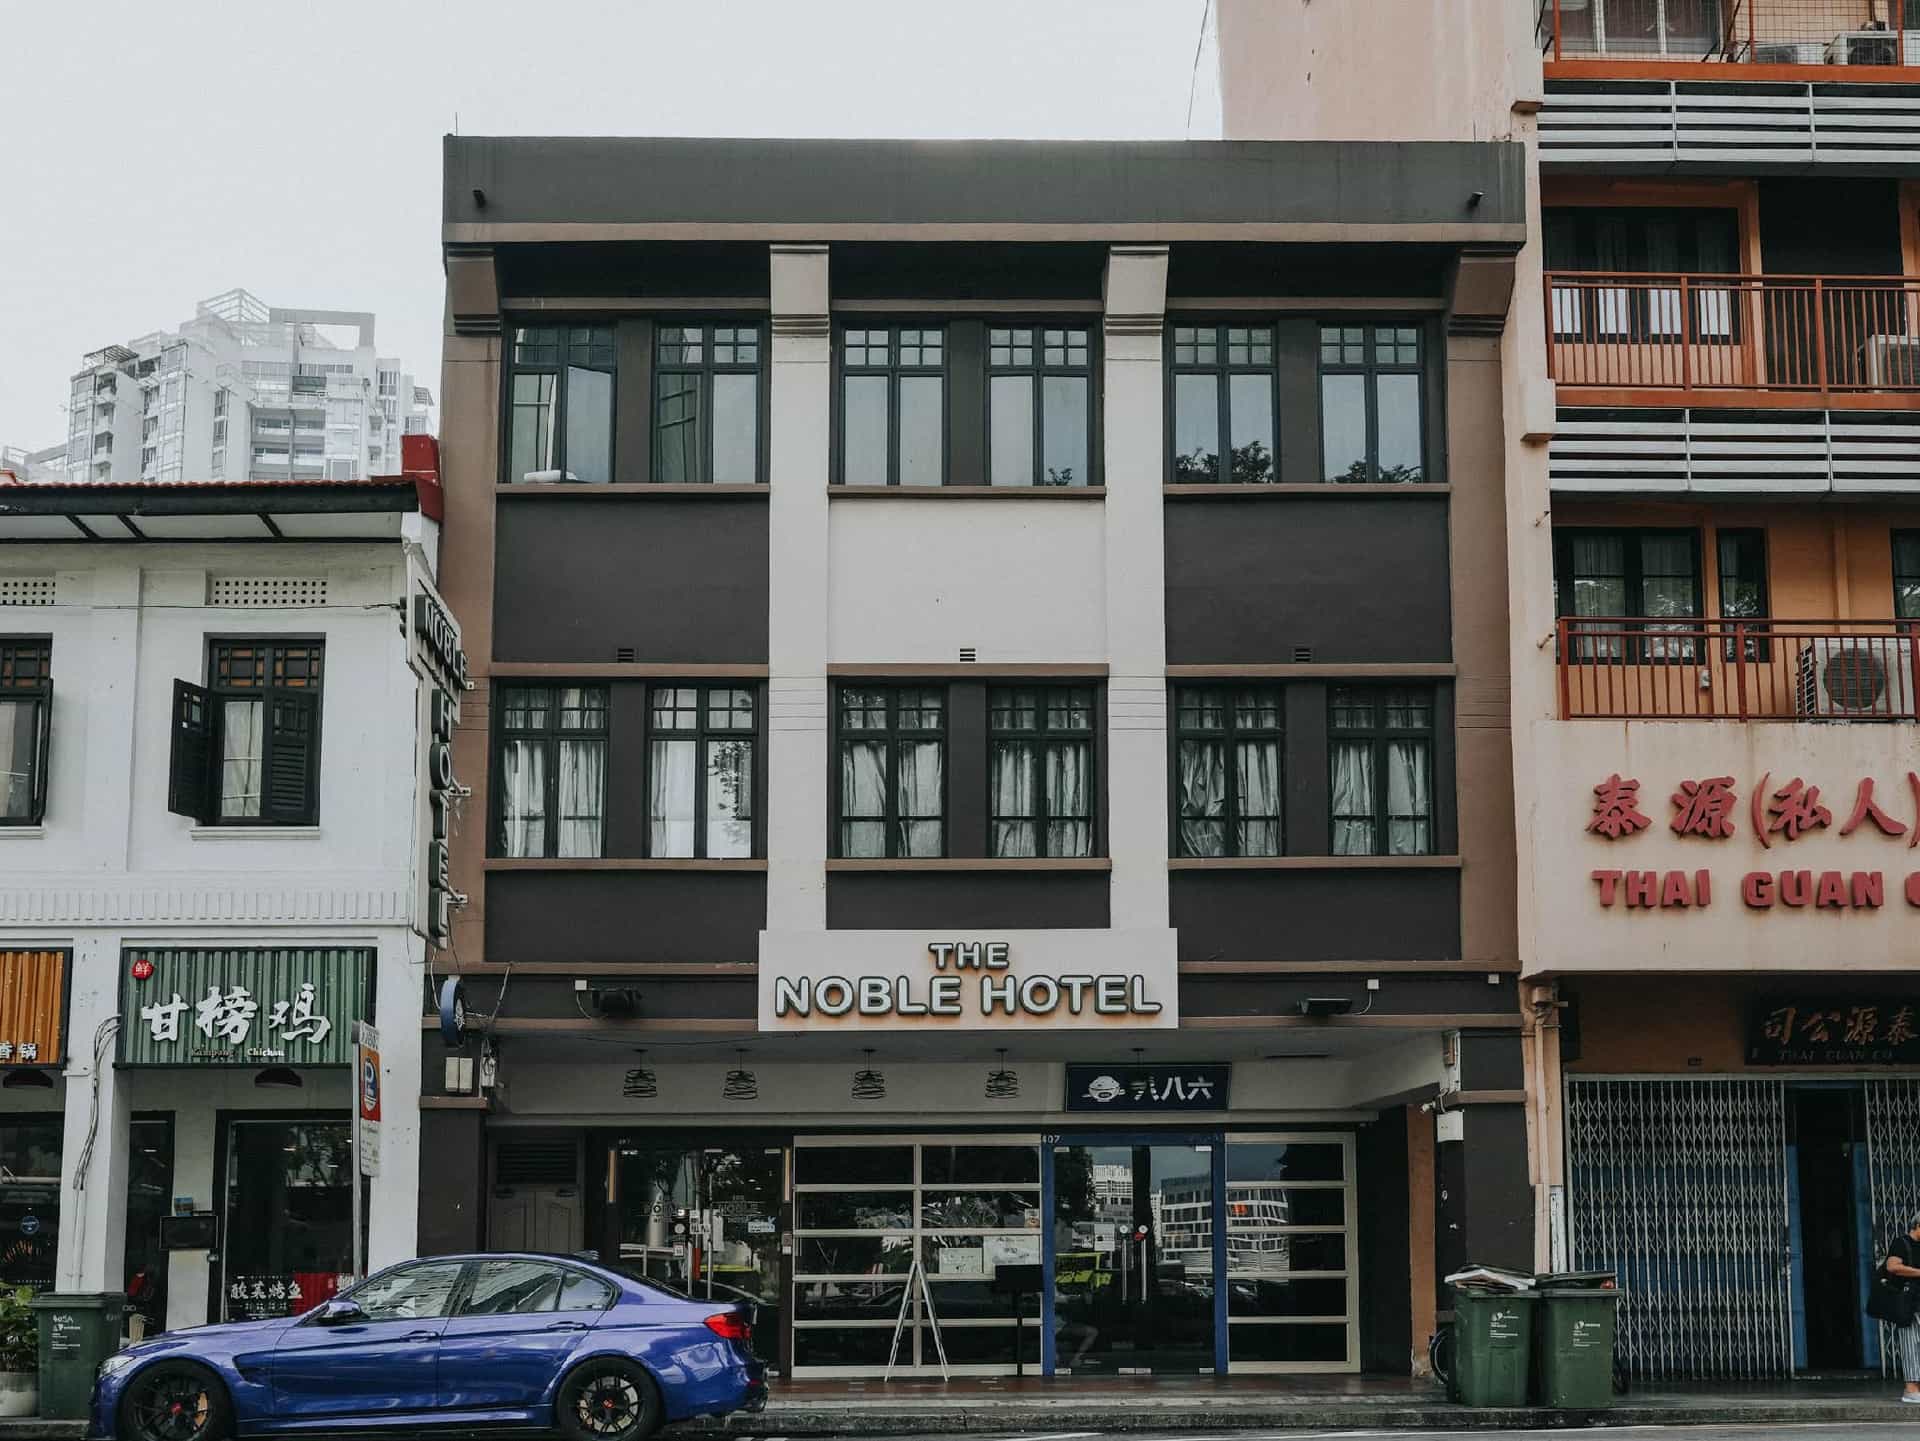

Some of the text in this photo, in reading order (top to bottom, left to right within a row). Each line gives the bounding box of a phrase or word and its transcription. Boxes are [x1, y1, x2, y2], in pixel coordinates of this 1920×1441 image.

[420, 596, 467, 690] NOBLE
[430, 689, 451, 937] HOTEL
[1591, 869, 1712, 908] THAI
[1742, 871, 1884, 909] GUAN
[928, 942, 1010, 970] THE
[774, 974, 1163, 1018] NOBLE HOTEL
